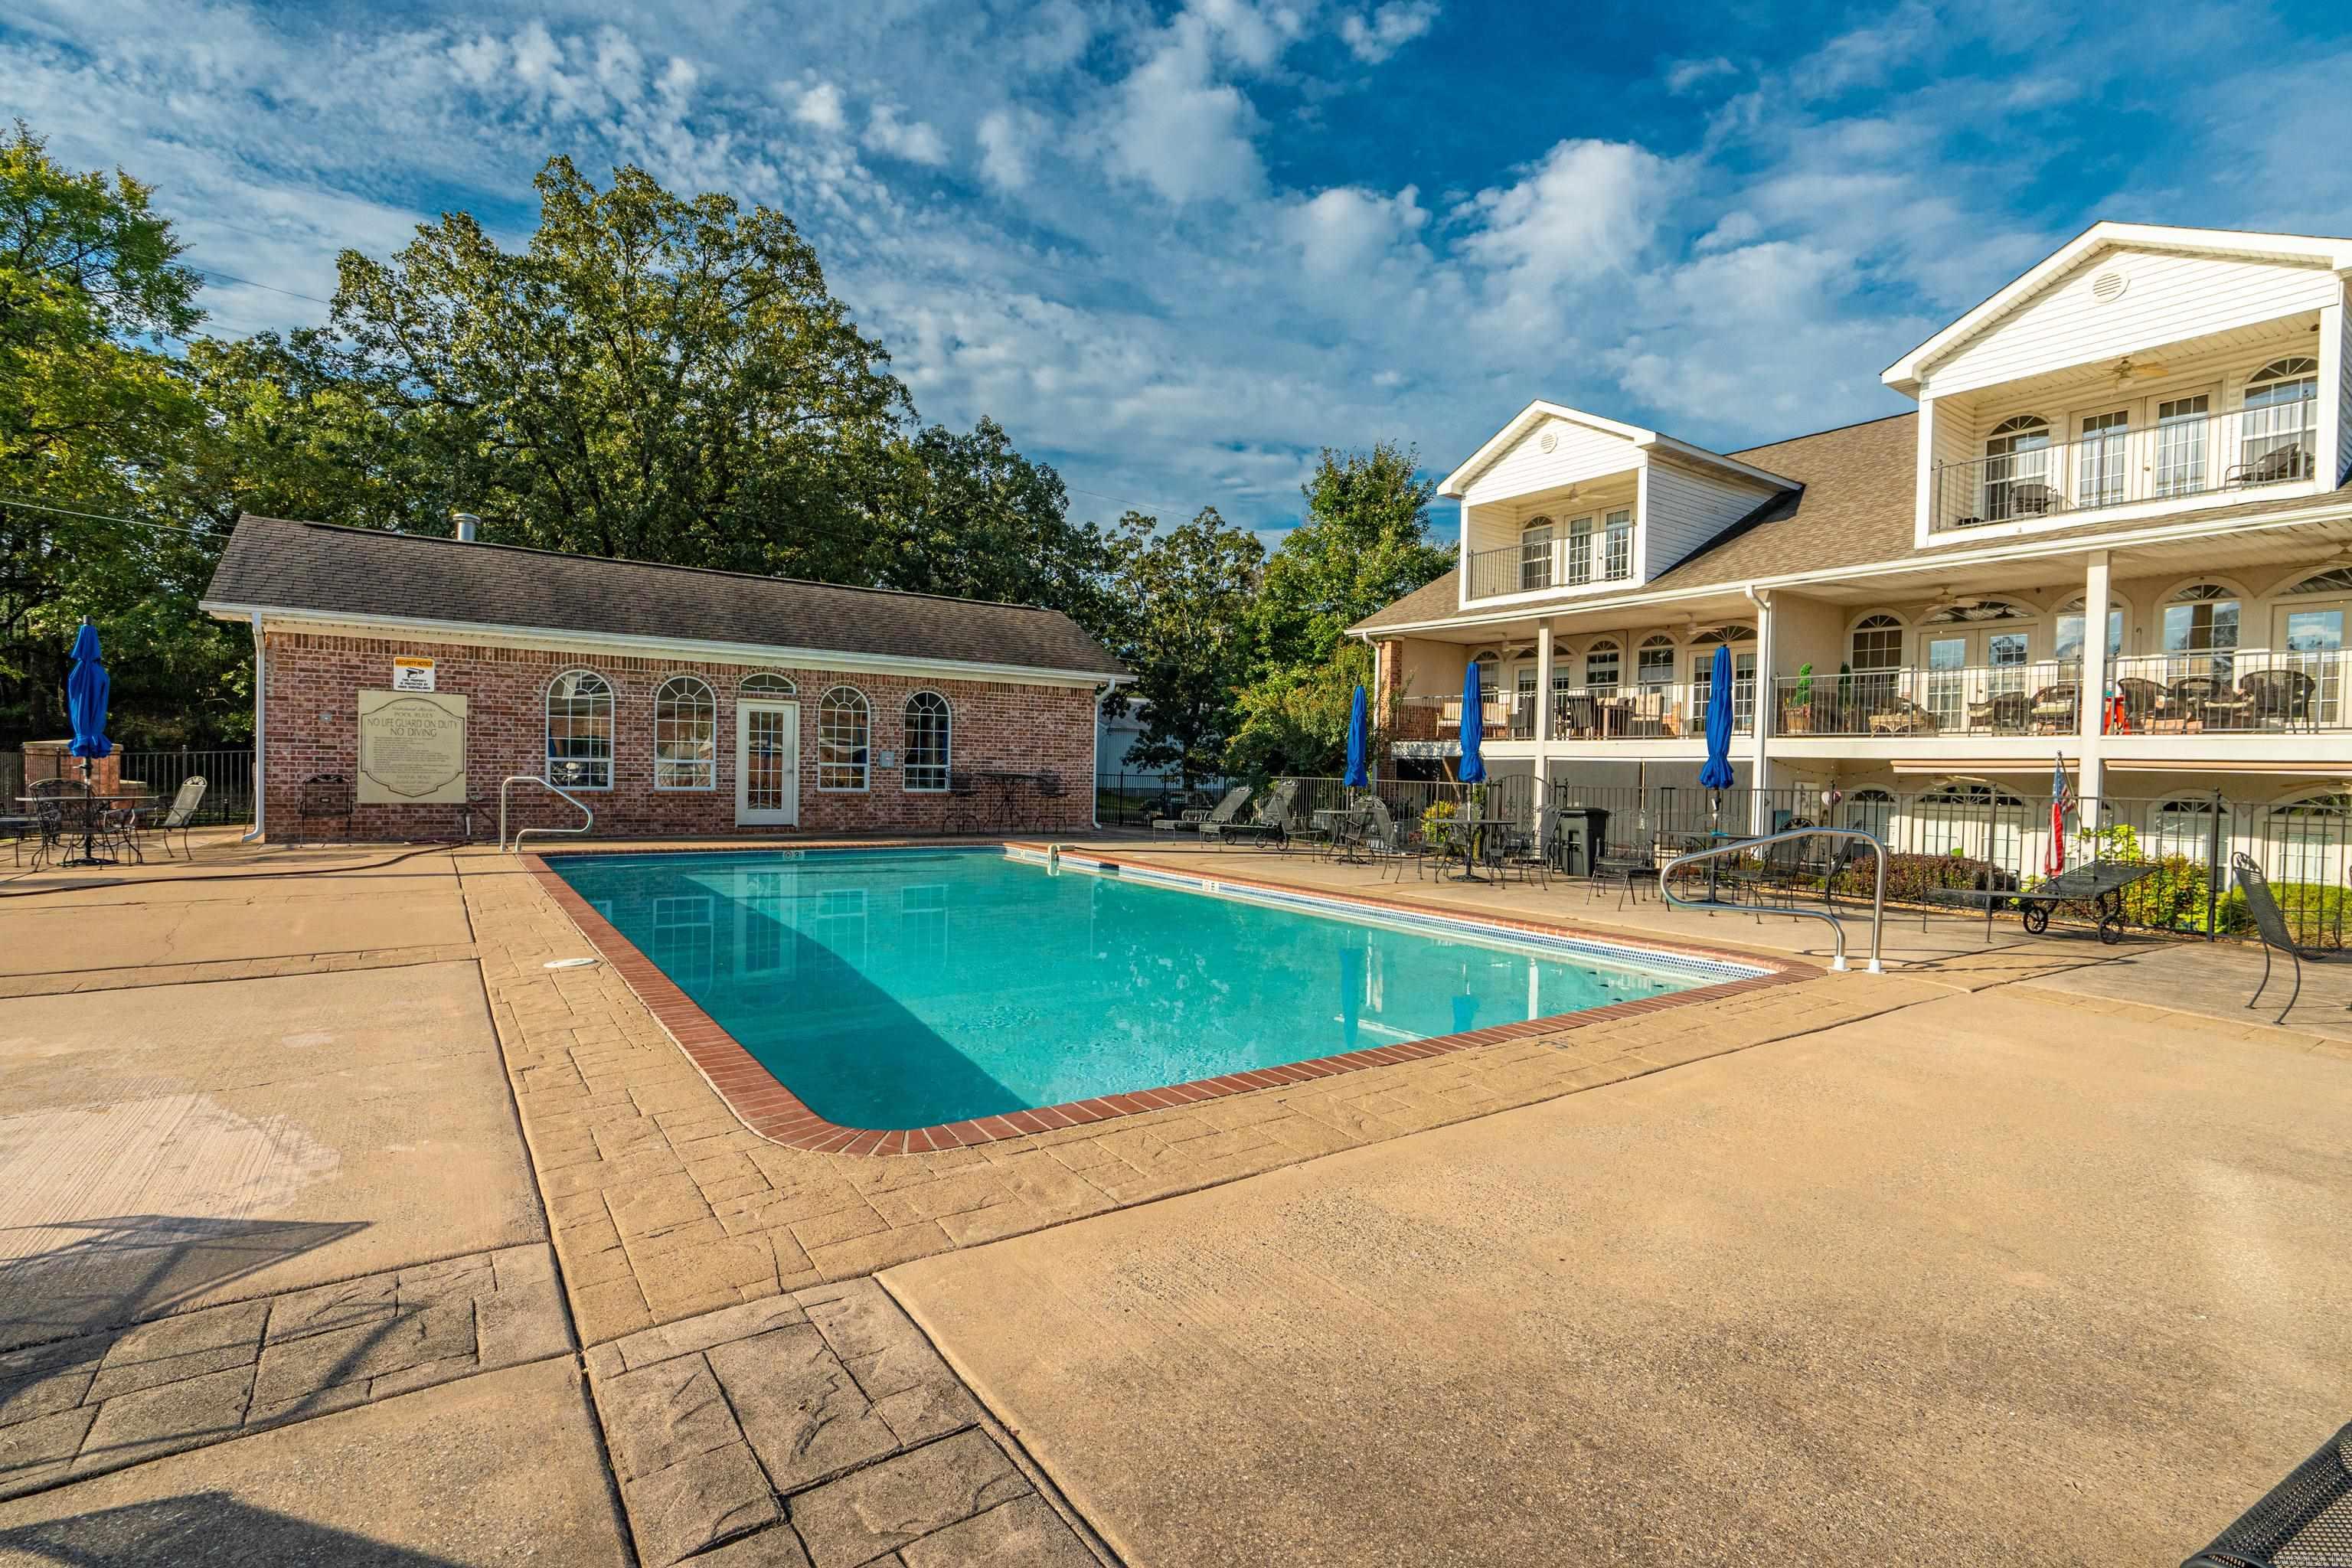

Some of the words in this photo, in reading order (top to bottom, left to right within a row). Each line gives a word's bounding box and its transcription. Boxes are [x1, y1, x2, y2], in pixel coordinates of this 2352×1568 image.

[368, 717, 380, 727] NO
[381, 718, 394, 727] LIFE
[395, 718, 422, 728] GUARD
[423, 719, 436, 728] ON
[437, 720, 458, 729] DUTY
[390, 727, 404, 737] NO
[407, 728, 436, 737] DIVING
